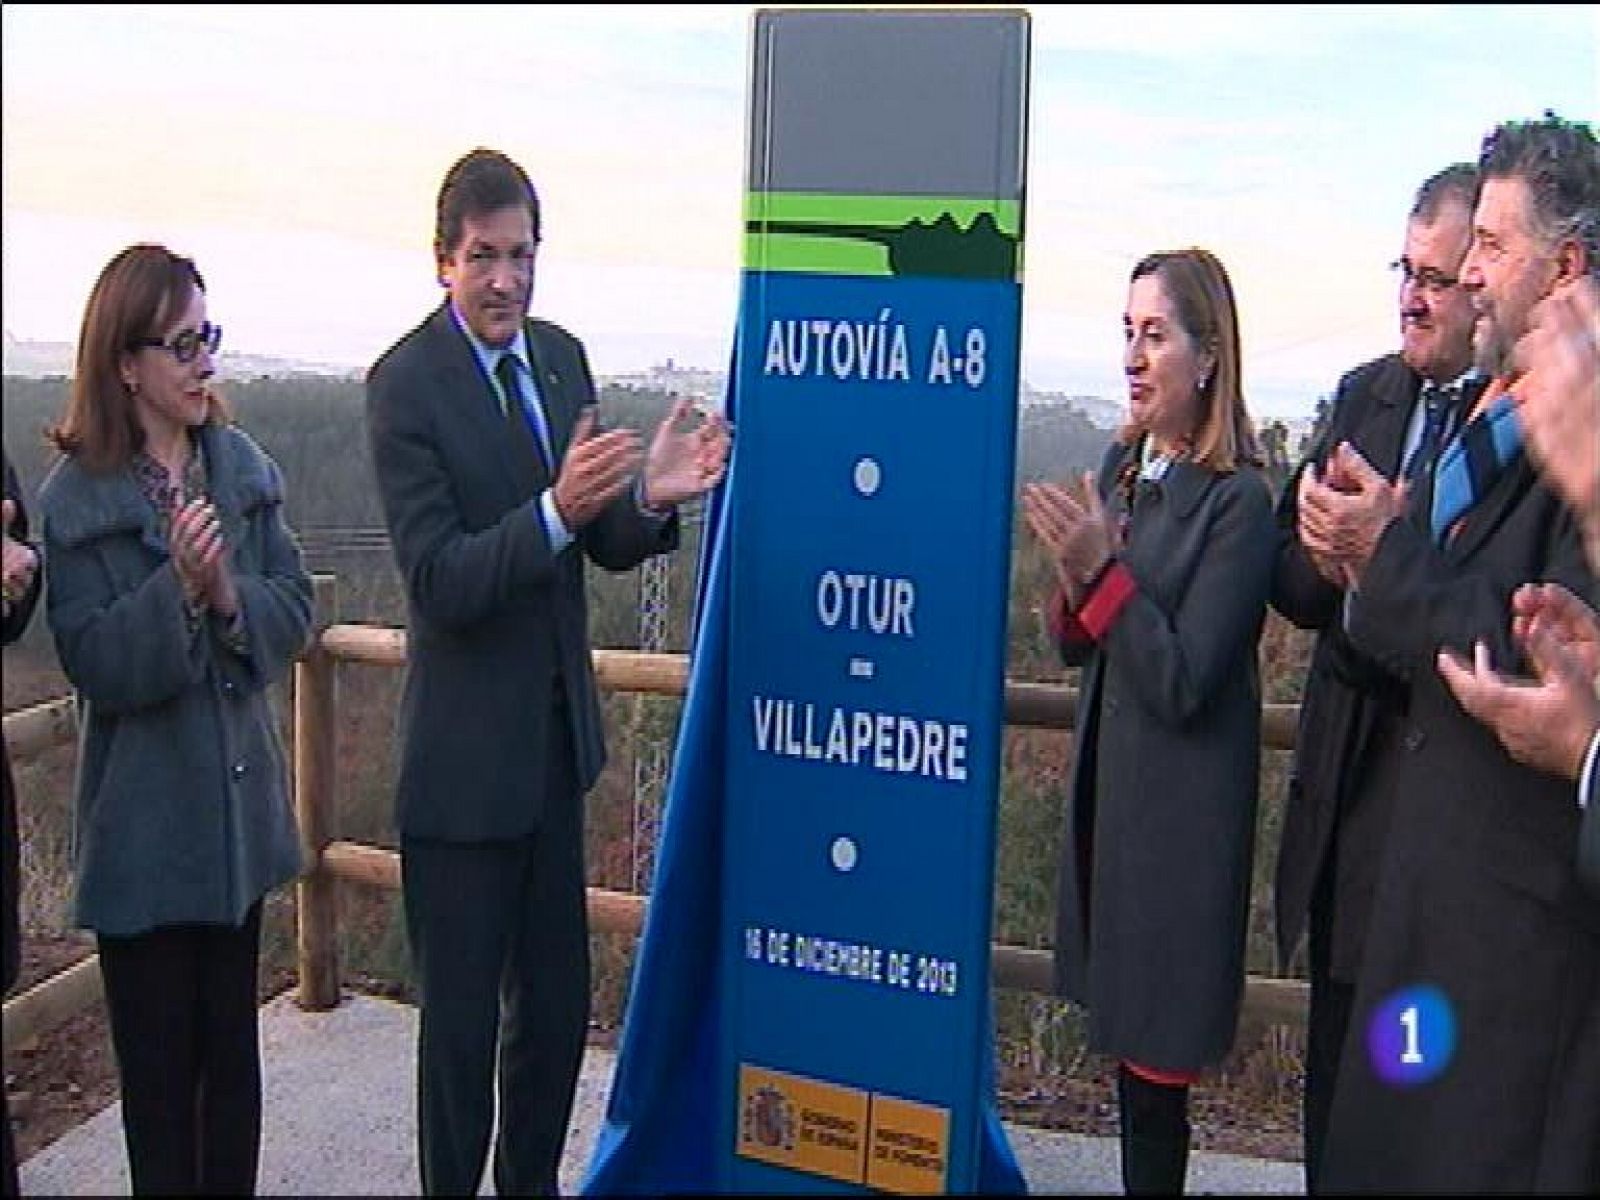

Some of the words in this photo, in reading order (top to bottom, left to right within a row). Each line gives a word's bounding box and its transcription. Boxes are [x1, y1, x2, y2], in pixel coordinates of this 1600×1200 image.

[764, 307, 910, 380] AUTOVÍA
[928, 328, 987, 387] A-8
[818, 570, 916, 637] OTUR
[753, 695, 968, 781] VILLAPEDRE
[768, 929, 790, 966] DE
[796, 935, 882, 982] DICIEMBRE
[888, 953, 911, 989] DE
[917, 956, 958, 996] 2013
